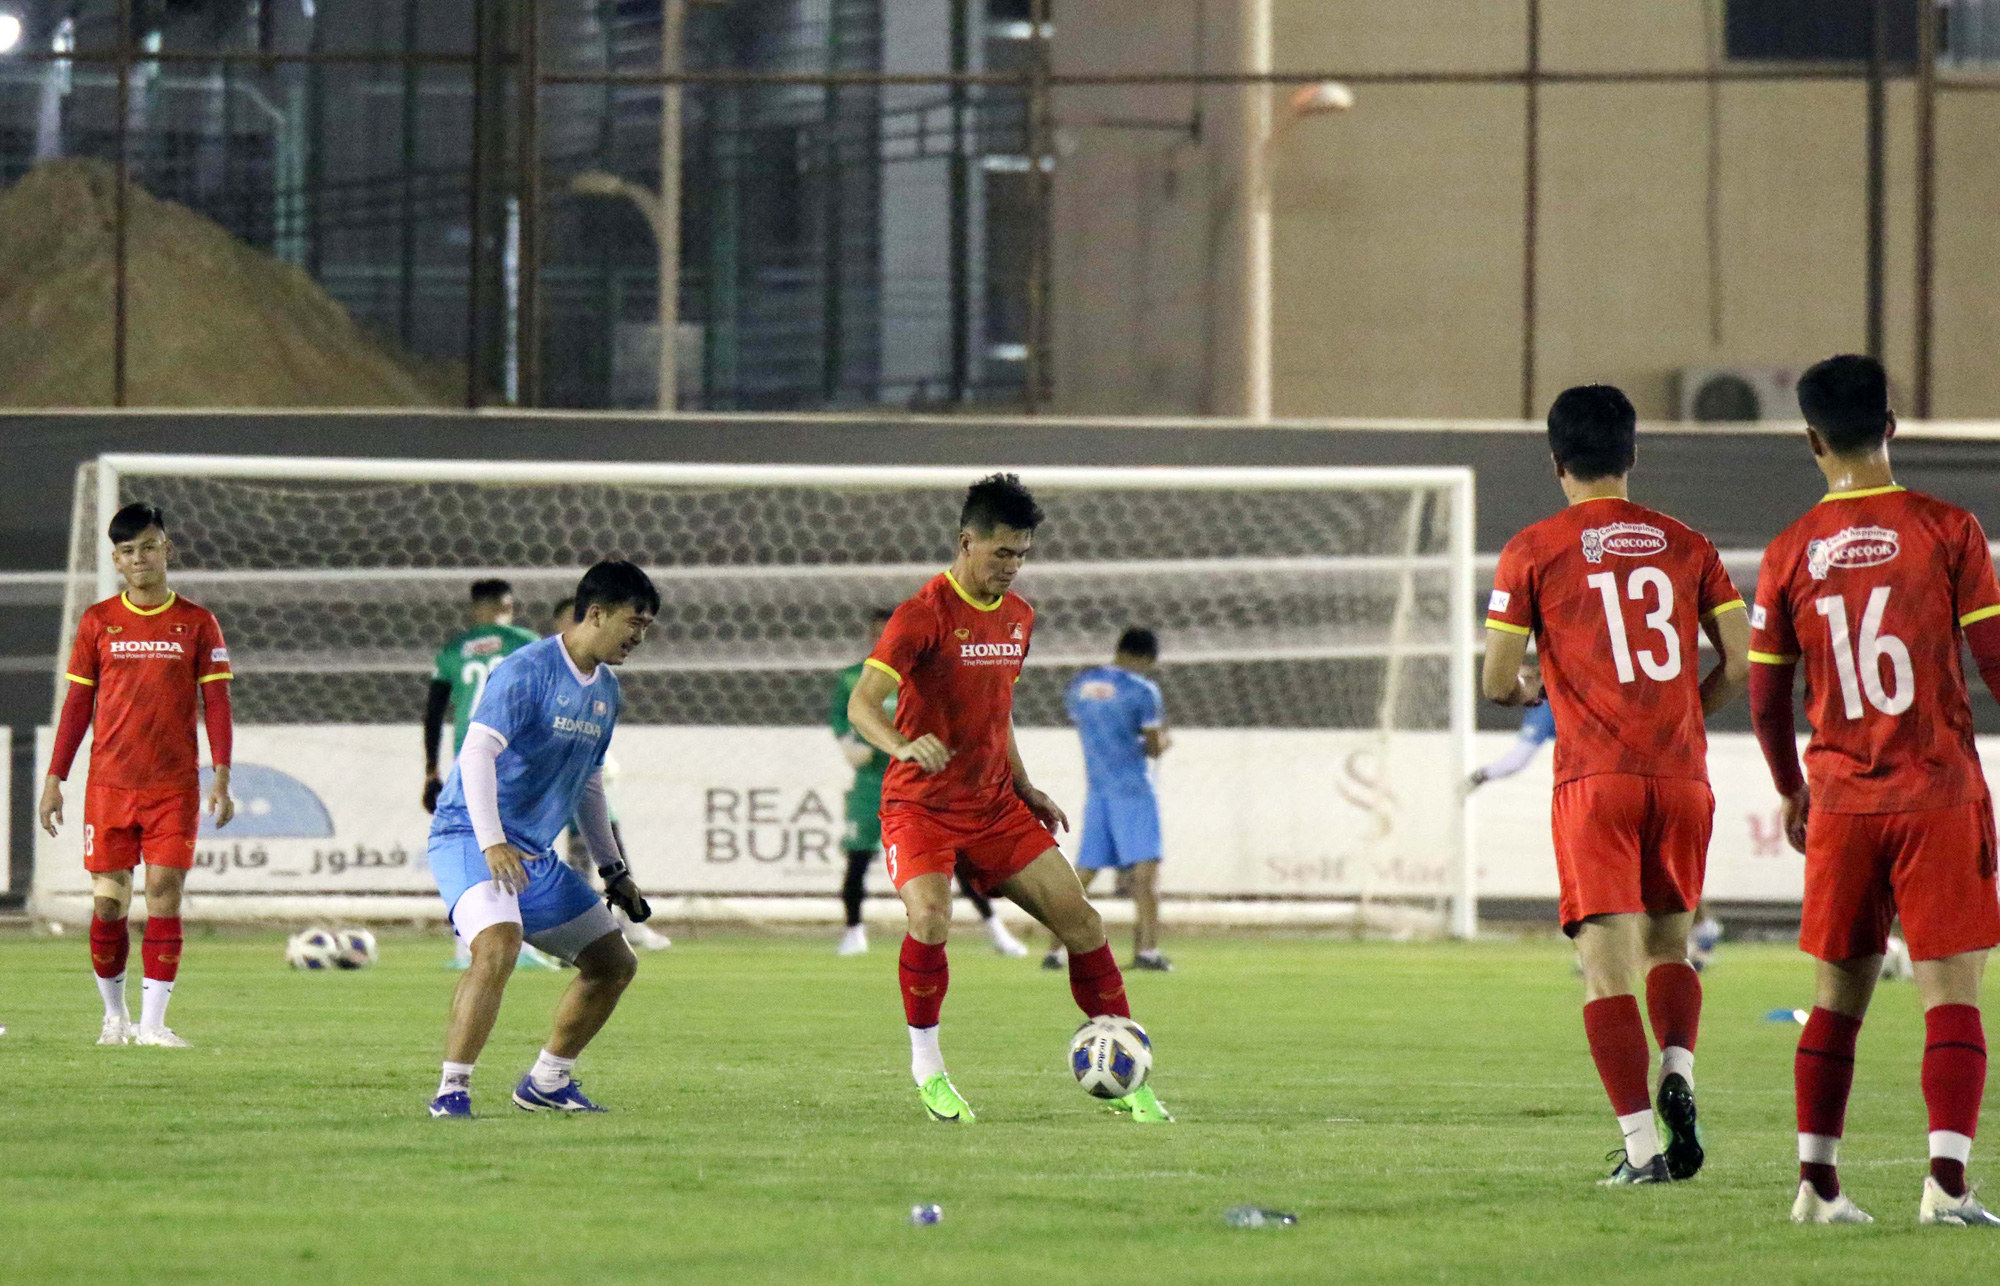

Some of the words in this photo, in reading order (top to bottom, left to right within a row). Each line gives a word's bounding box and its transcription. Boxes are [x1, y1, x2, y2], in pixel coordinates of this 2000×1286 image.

[1587, 566, 1682, 684] 13
[110, 641, 184, 653] HONDA
[960, 643, 1023, 658] HONDA
[1815, 586, 1915, 720] 16
[553, 716, 602, 738] HONDA
[705, 786, 850, 824] REA
